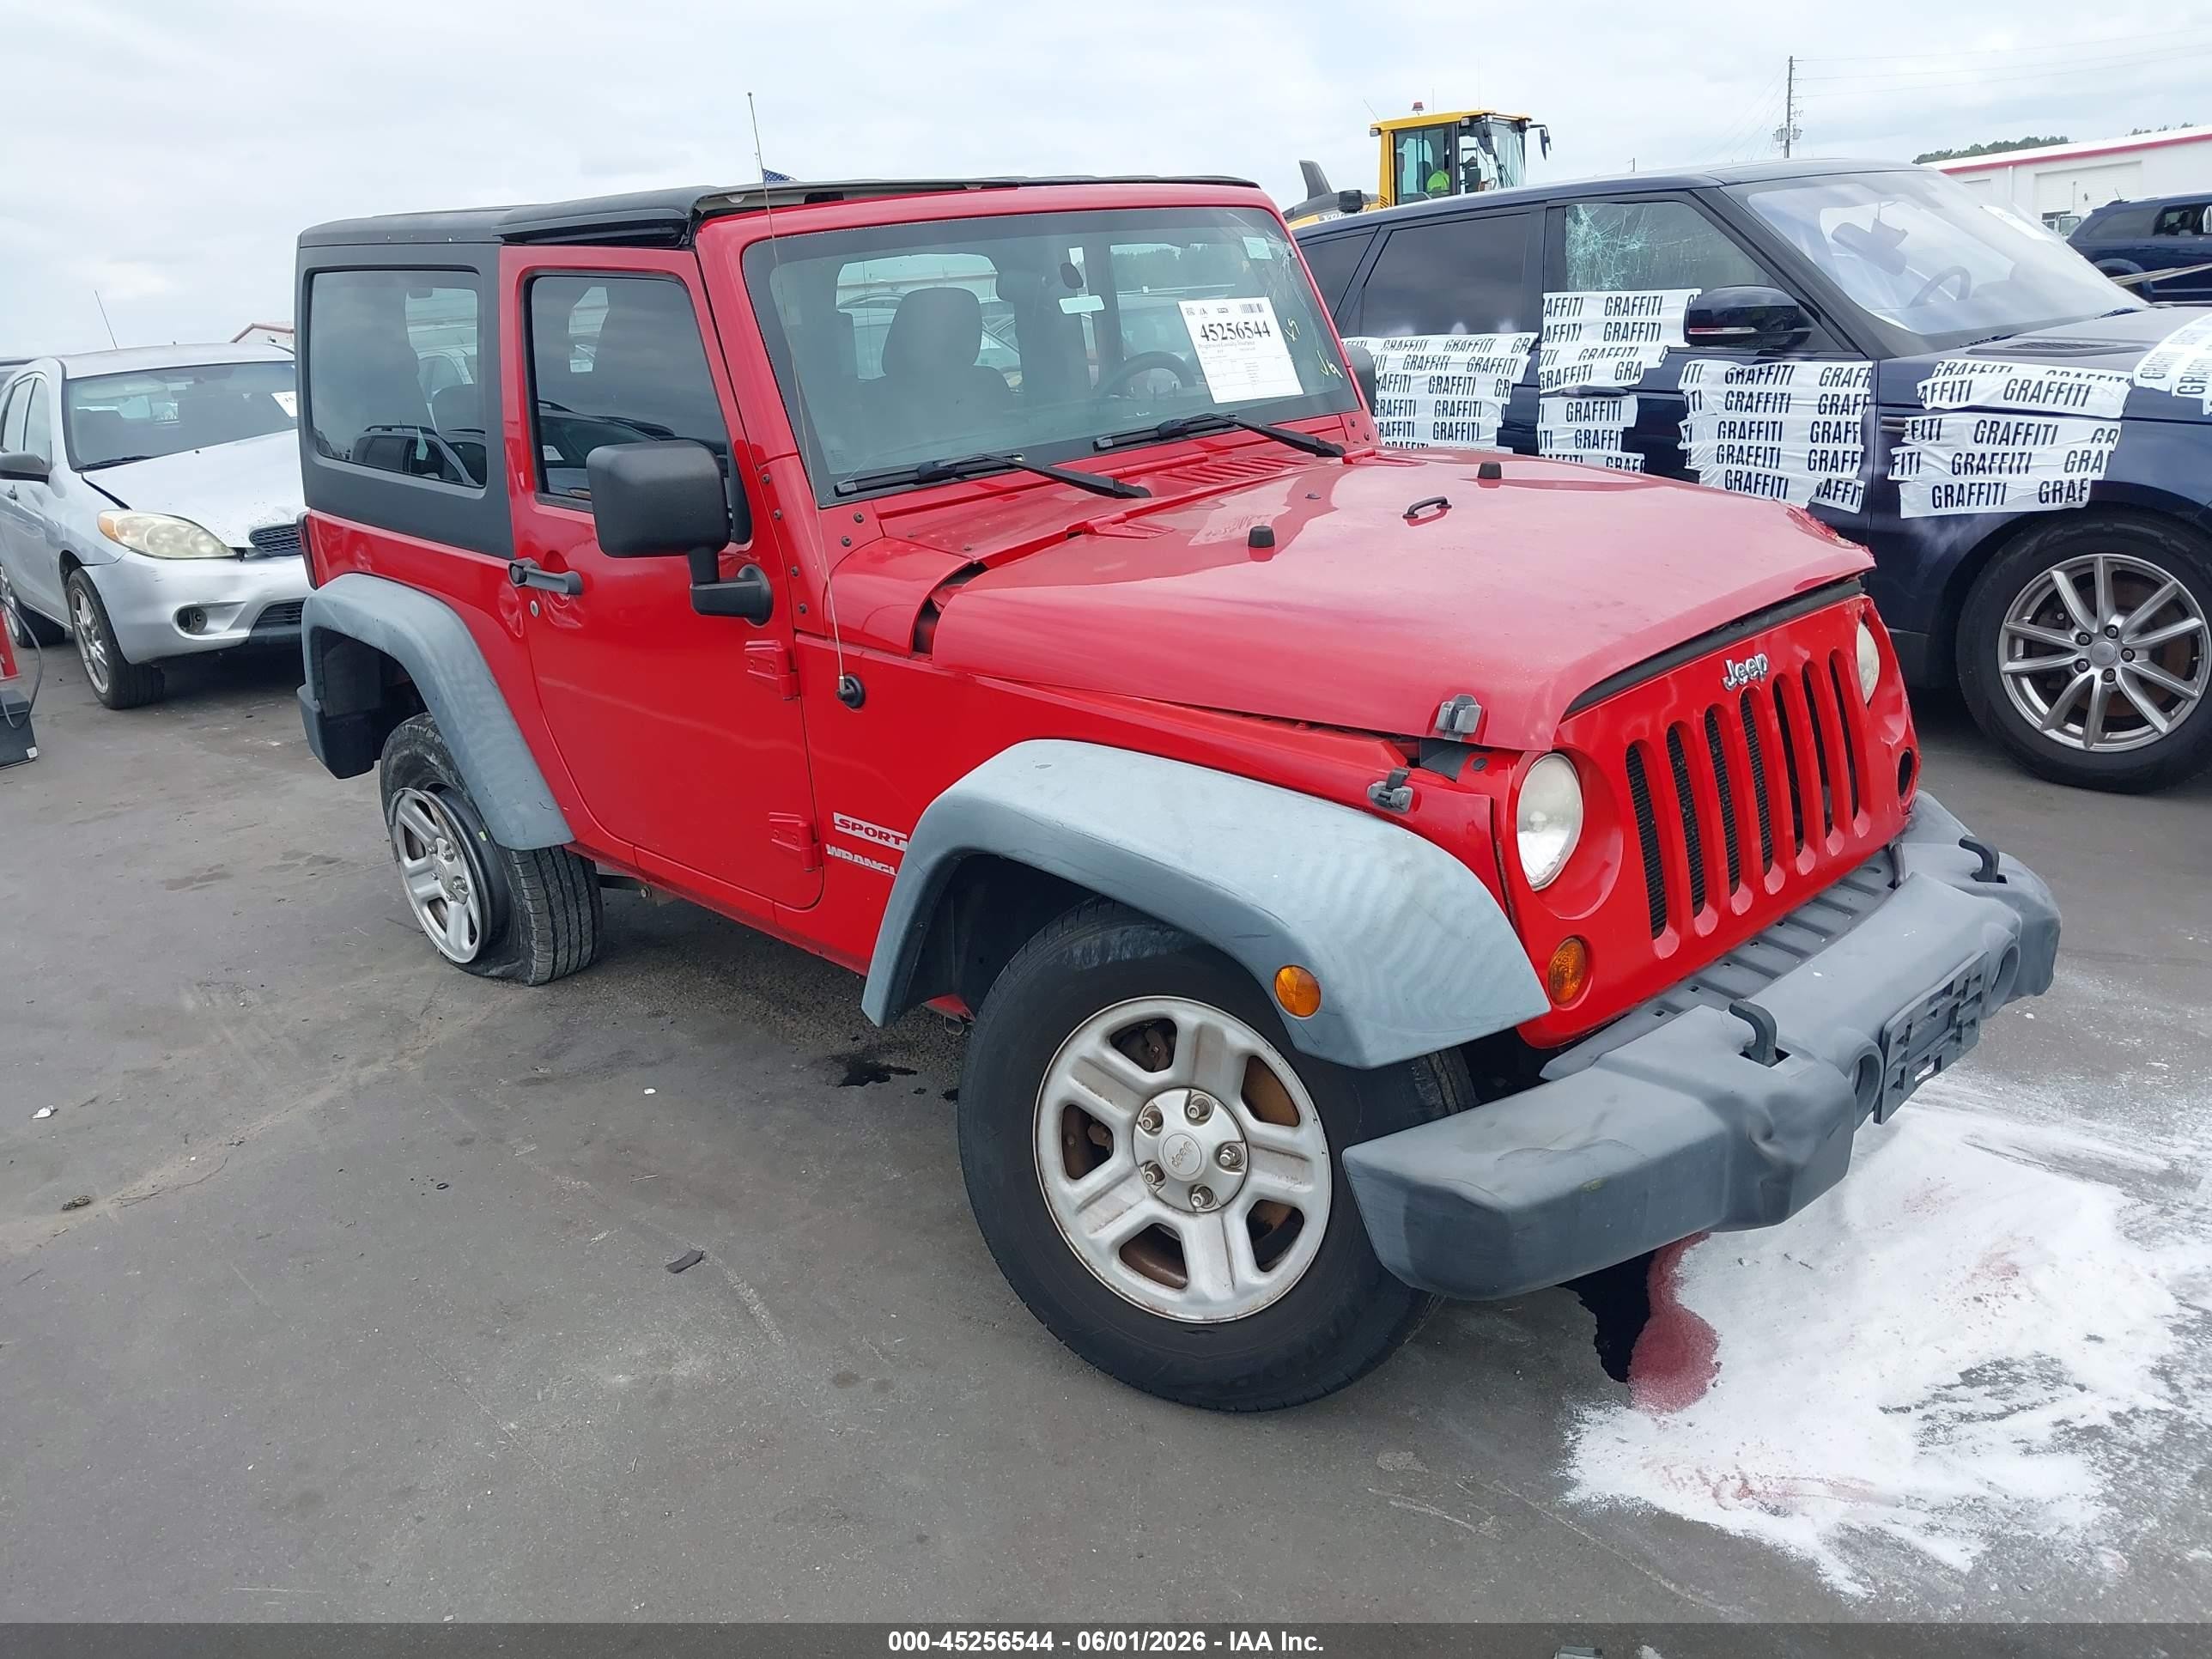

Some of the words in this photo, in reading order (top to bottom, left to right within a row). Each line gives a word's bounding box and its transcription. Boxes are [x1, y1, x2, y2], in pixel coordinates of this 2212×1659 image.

[1543, 297, 1583, 317] AFFITI
[1604, 295, 1662, 316] GRAFFITI
[1200, 320, 1271, 342] 45256544
[1603, 322, 1662, 342] GRAFFITI
[1381, 340, 1429, 352] GRAFFITI
[1443, 338, 1496, 353] GRAFFITI
[1403, 355, 1451, 371] GRAFFITI
[1467, 357, 1518, 376] GRAFFITI
[1540, 364, 1594, 390] GRAFFITI
[1614, 361, 1642, 381] GRA
[1725, 365, 1795, 386] GRAFFITI
[1429, 375, 1477, 396] GRAFFITI
[2002, 379, 2092, 407] GRAFFITI
[1434, 400, 1482, 417] GRAFFITI
[1566, 400, 1621, 422] GRAFFITI
[1724, 391, 1791, 414] GRAFFITI
[1376, 421, 1415, 438] RAFFITI
[1433, 422, 1480, 441] GRAFFITI
[1540, 430, 1553, 449] ITI
[1717, 421, 1783, 441] GRAFFITI
[1810, 421, 1860, 444] GRAFF
[1905, 418, 1942, 441] FITI
[1975, 419, 2059, 447] GRAFFITI
[1717, 445, 1781, 469] GRAFFITI
[1808, 449, 1859, 472] GRAFF
[1891, 452, 1922, 476] FITI
[1951, 452, 2032, 476] GRAFFITI
[1724, 470, 1789, 500] GRAFFITI
[1932, 483, 2007, 508] GRAFFITI
[2039, 477, 2088, 505] GRAF
[1722, 653, 1769, 691] Jeep
[838, 818, 903, 846] SPORT
